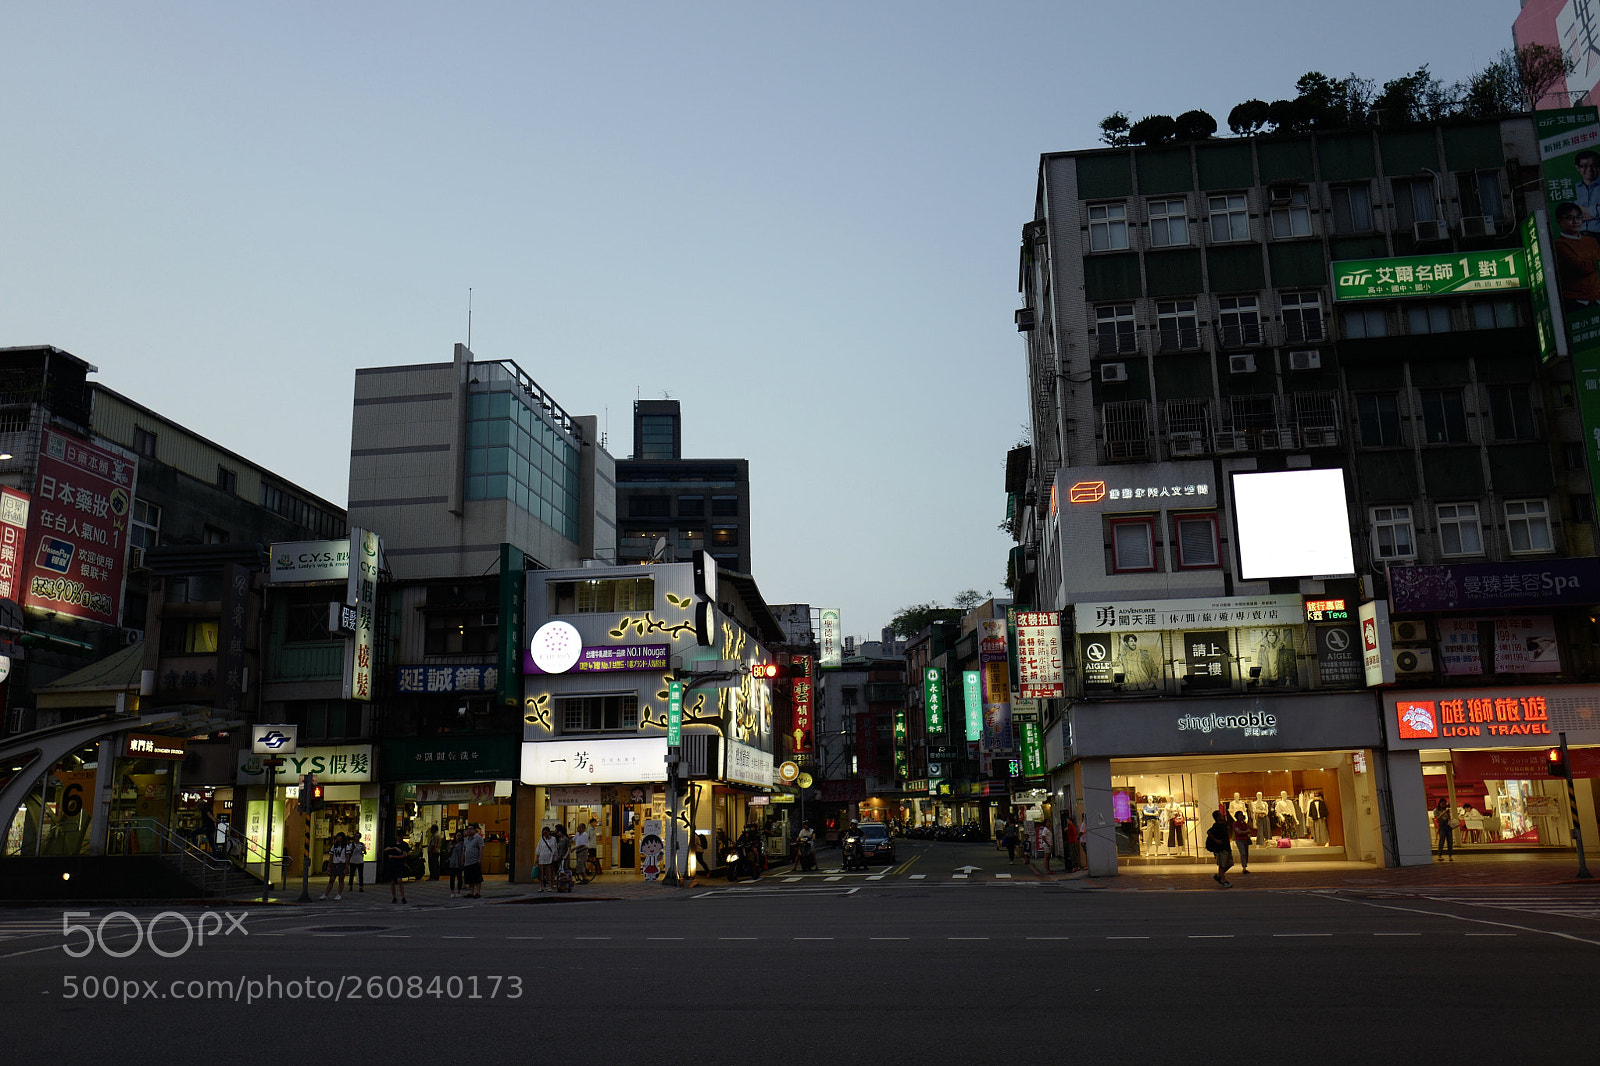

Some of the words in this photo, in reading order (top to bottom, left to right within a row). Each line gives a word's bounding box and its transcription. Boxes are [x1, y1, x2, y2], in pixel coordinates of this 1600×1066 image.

[1375, 262, 1453, 284] 艾爾名師
[1478, 259, 1498, 278] 對
[40, 473, 110, 520] 日本藥妝
[360, 561, 376, 576] CYS
[1017, 612, 1059, 627] 改裝拍賣
[1096, 605, 1115, 627] 勇
[1119, 614, 1157, 627] 闖天涯
[1326, 610, 1348, 619] Teva
[626, 646, 641, 657] NO.1
[642, 646, 666, 659] Nougat
[1192, 643, 1221, 657] 請上
[1085, 662, 1110, 670] AIGLE
[1194, 662, 1222, 677] 二樓
[1439, 696, 1548, 725] 雄獅旅遊
[1178, 711, 1276, 733] singlenoble
[1442, 726, 1486, 737] LION
[1488, 723, 1556, 736] TRAVEL
[130, 739, 154, 752] 東門站
[329, 754, 368, 775] 假髮
[549, 751, 590, 770] 一芳
[63, 783, 83, 817] 6
